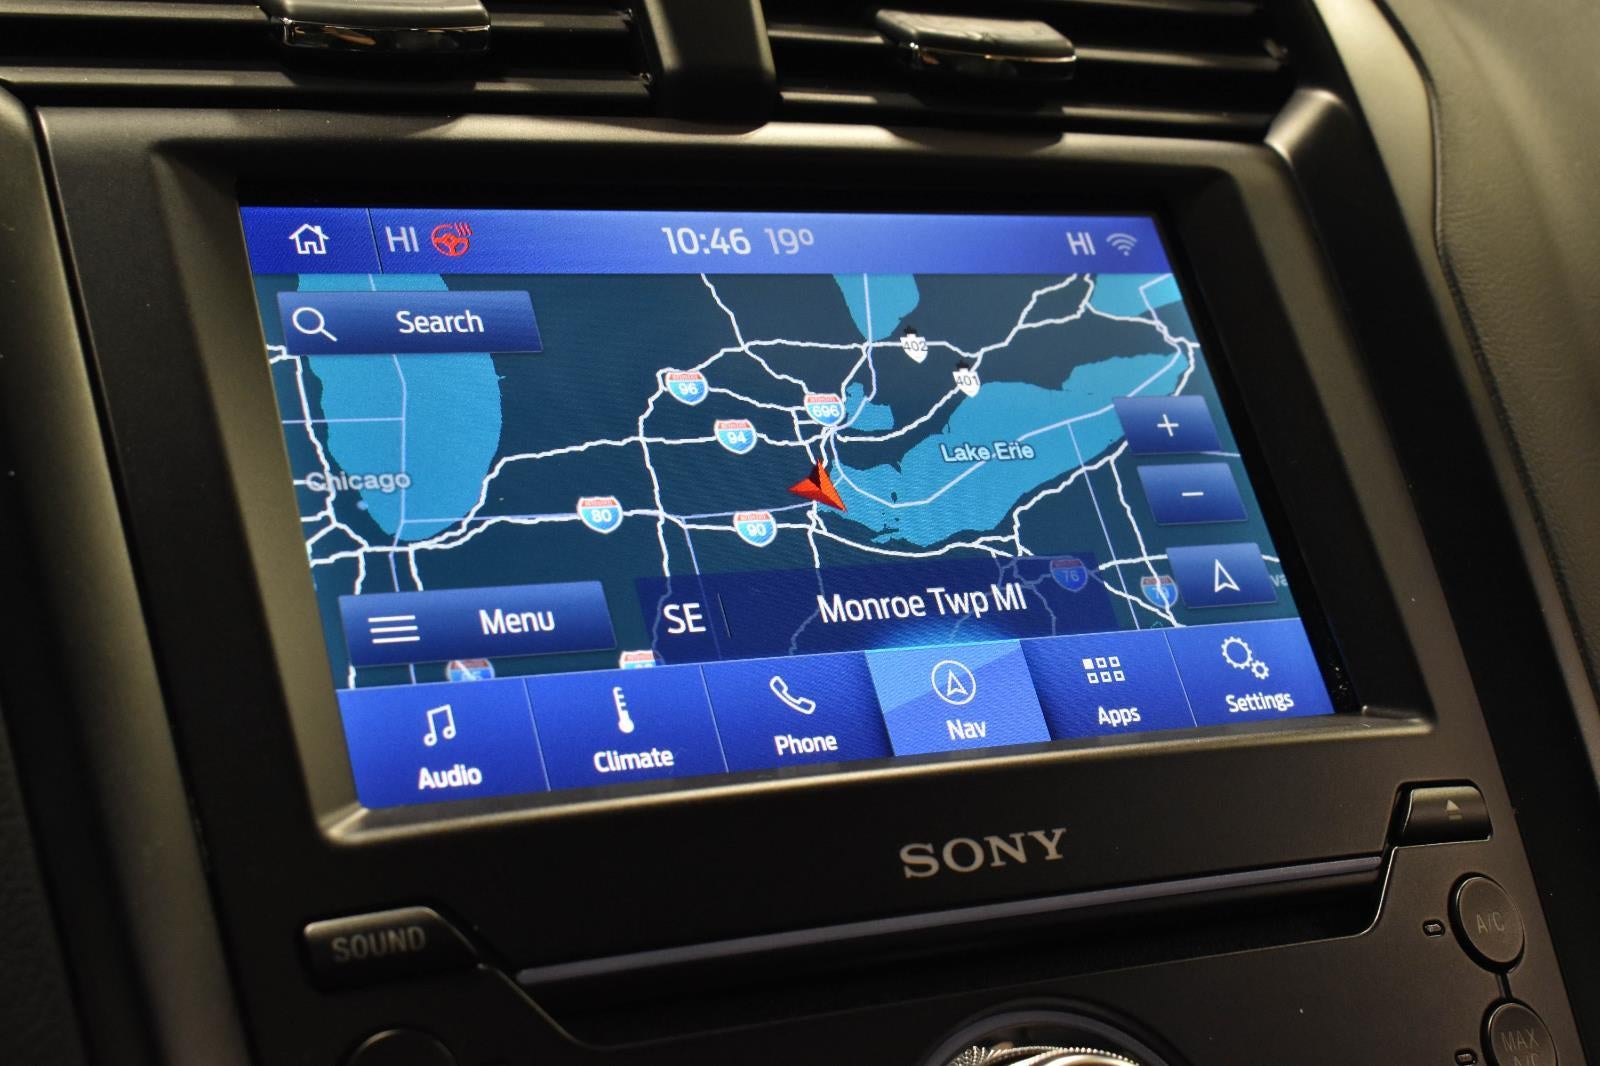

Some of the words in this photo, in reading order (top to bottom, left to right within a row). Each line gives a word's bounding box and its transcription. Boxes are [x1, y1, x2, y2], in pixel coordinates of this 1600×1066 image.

[385, 226, 420, 253] HI
[661, 226, 752, 256] 10:46
[1066, 231, 1096, 256] HI
[396, 310, 485, 335] Search
[903, 340, 929, 352] 402
[677, 382, 699, 396] 96
[957, 375, 981, 386] 401
[812, 404, 841, 418] 696
[726, 431, 747, 445] 94
[940, 442, 990, 463] Lake
[992, 440, 1035, 461] Erie
[305, 471, 411, 494] Chicago
[590, 508, 613, 523] 80
[745, 523, 767, 537] 90
[1062, 569, 1080, 583] 76
[816, 592, 927, 624] Monroe
[927, 586, 989, 619] Twp
[992, 583, 1028, 612] MI
[479, 607, 555, 636] Menu
[663, 603, 707, 634] SE
[1224, 690, 1295, 714] Settings
[1097, 704, 1141, 728] Apps
[946, 718, 987, 742] Nav
[774, 732, 838, 757] Phone
[593, 747, 675, 774] Climate
[418, 765, 483, 791] Audio
[899, 827, 1067, 878] SONY
[1476, 910, 1506, 935] A/C
[330, 925, 427, 963] SOUND
[1501, 1027, 1540, 1053] MAX
